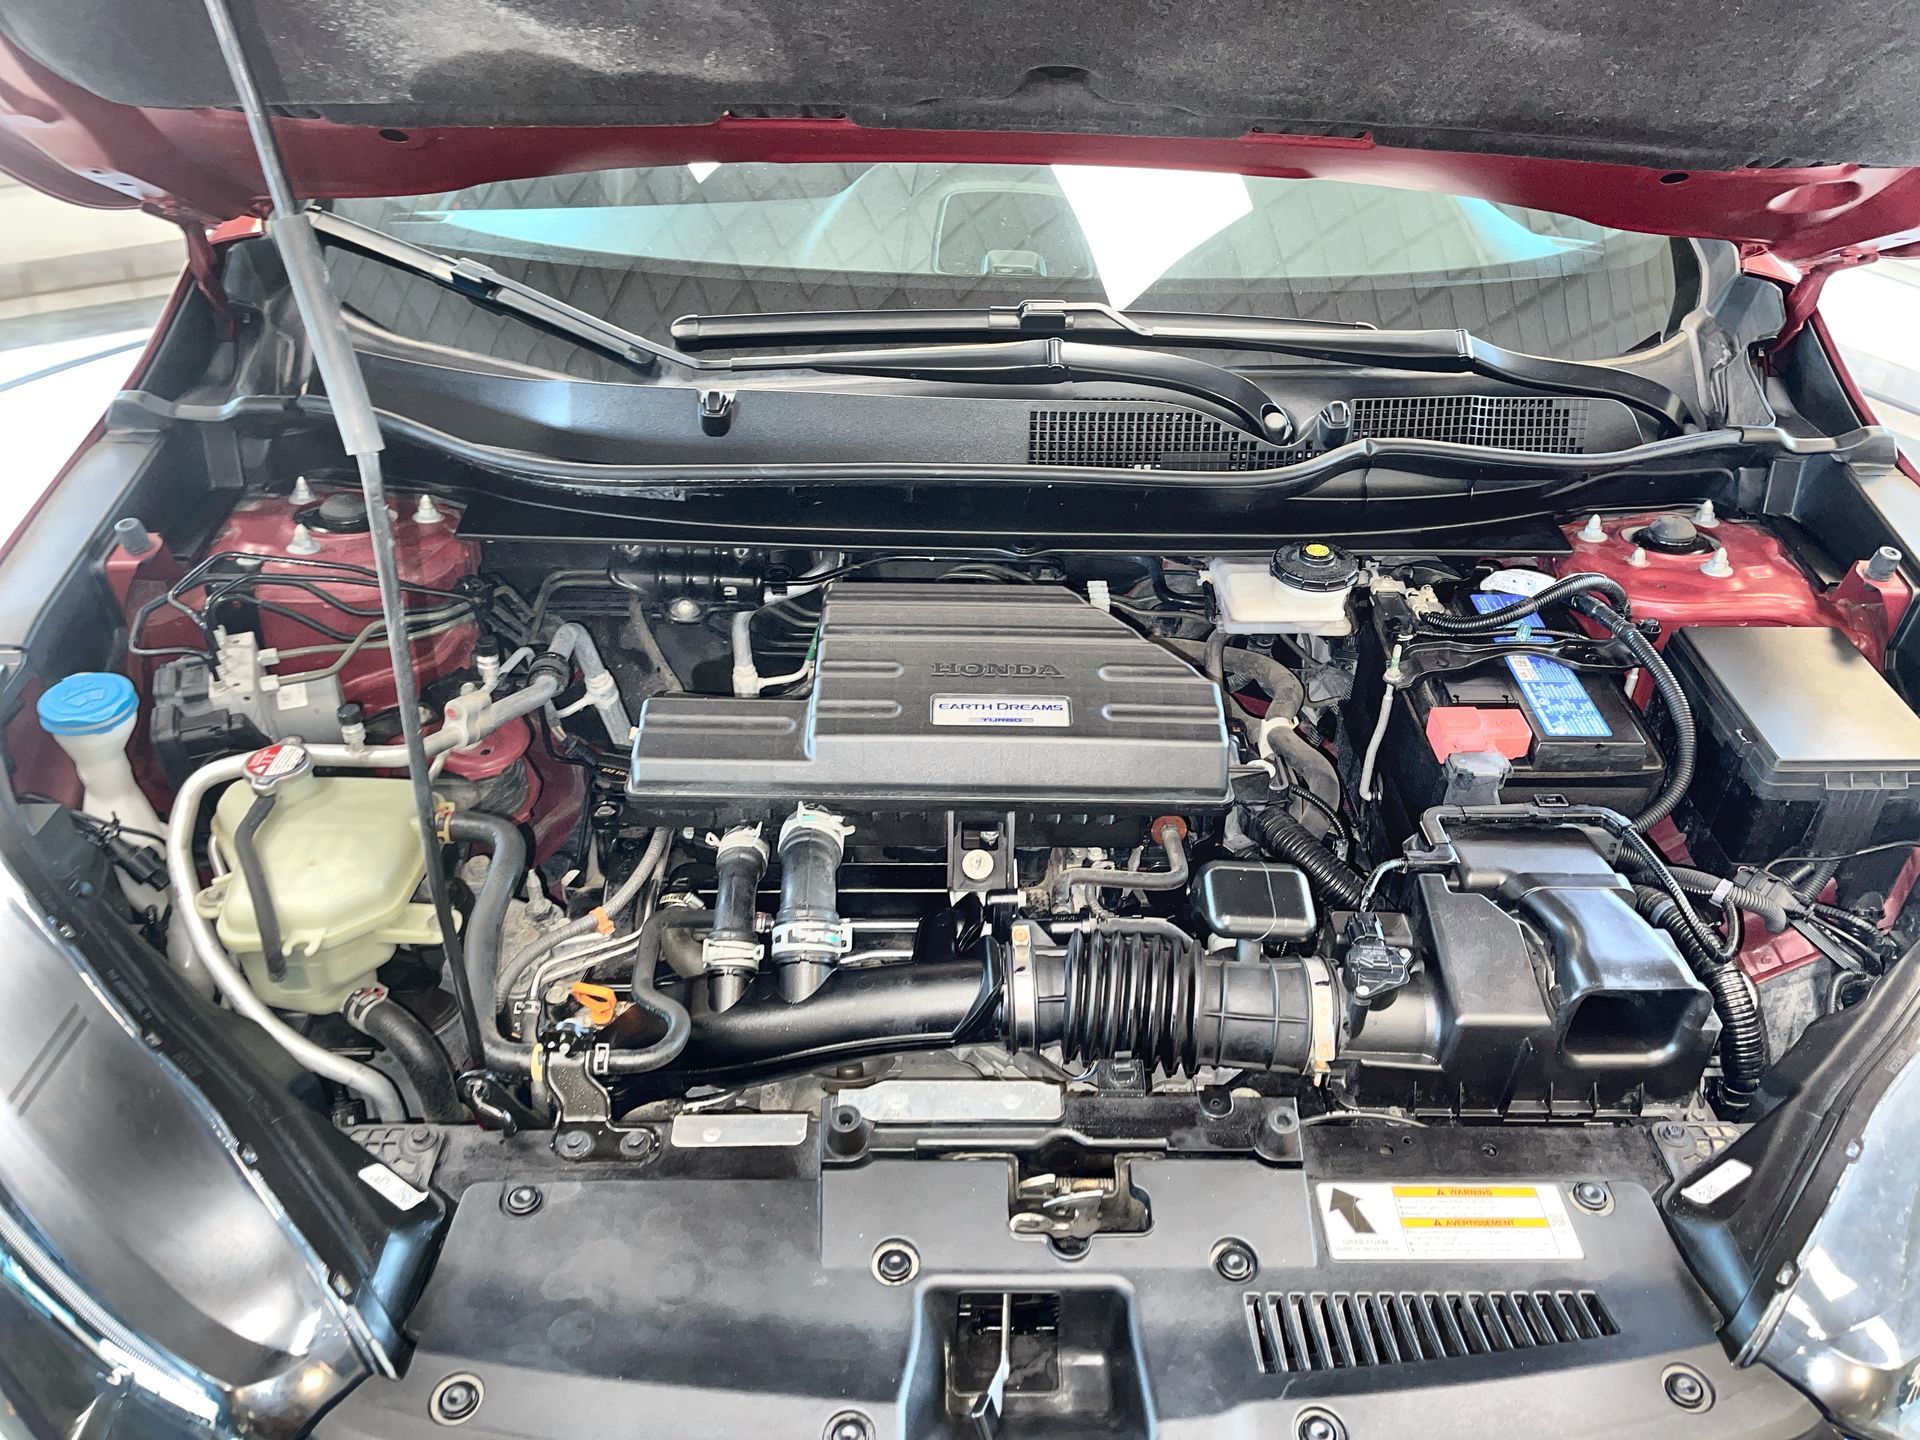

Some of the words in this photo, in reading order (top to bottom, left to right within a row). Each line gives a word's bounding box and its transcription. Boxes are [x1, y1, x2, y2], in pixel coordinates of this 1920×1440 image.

[931, 662, 1065, 678] HONDA
[938, 703, 992, 711] EARTH
[996, 702, 1064, 712] DREAMS
[1448, 1188, 1493, 1196] WARNING
[1445, 1218, 1516, 1227] AVERTISSEMENT
